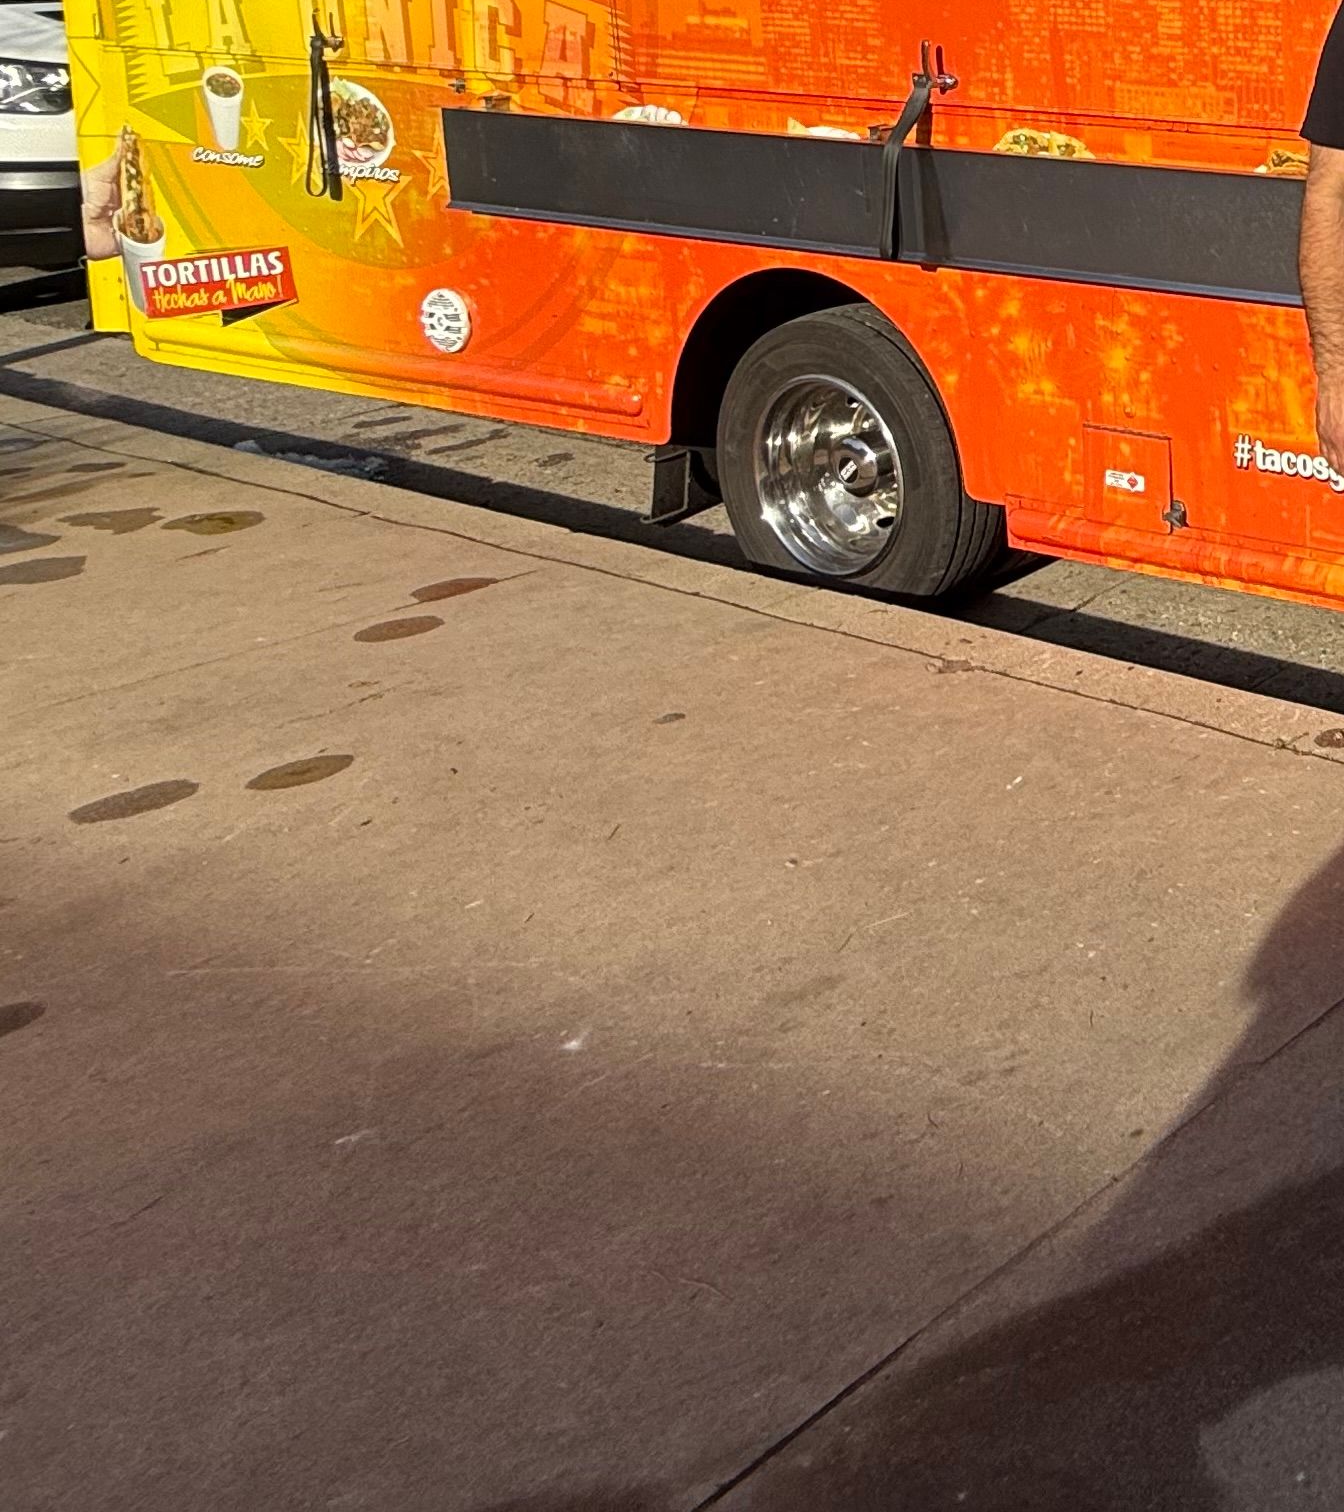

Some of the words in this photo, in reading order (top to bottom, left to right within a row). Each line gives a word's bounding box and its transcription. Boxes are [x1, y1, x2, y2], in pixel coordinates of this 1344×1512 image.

[142, 251, 284, 288] TORTILLAS
[153, 284, 209, 312] Hechas
[211, 290, 227, 305] a
